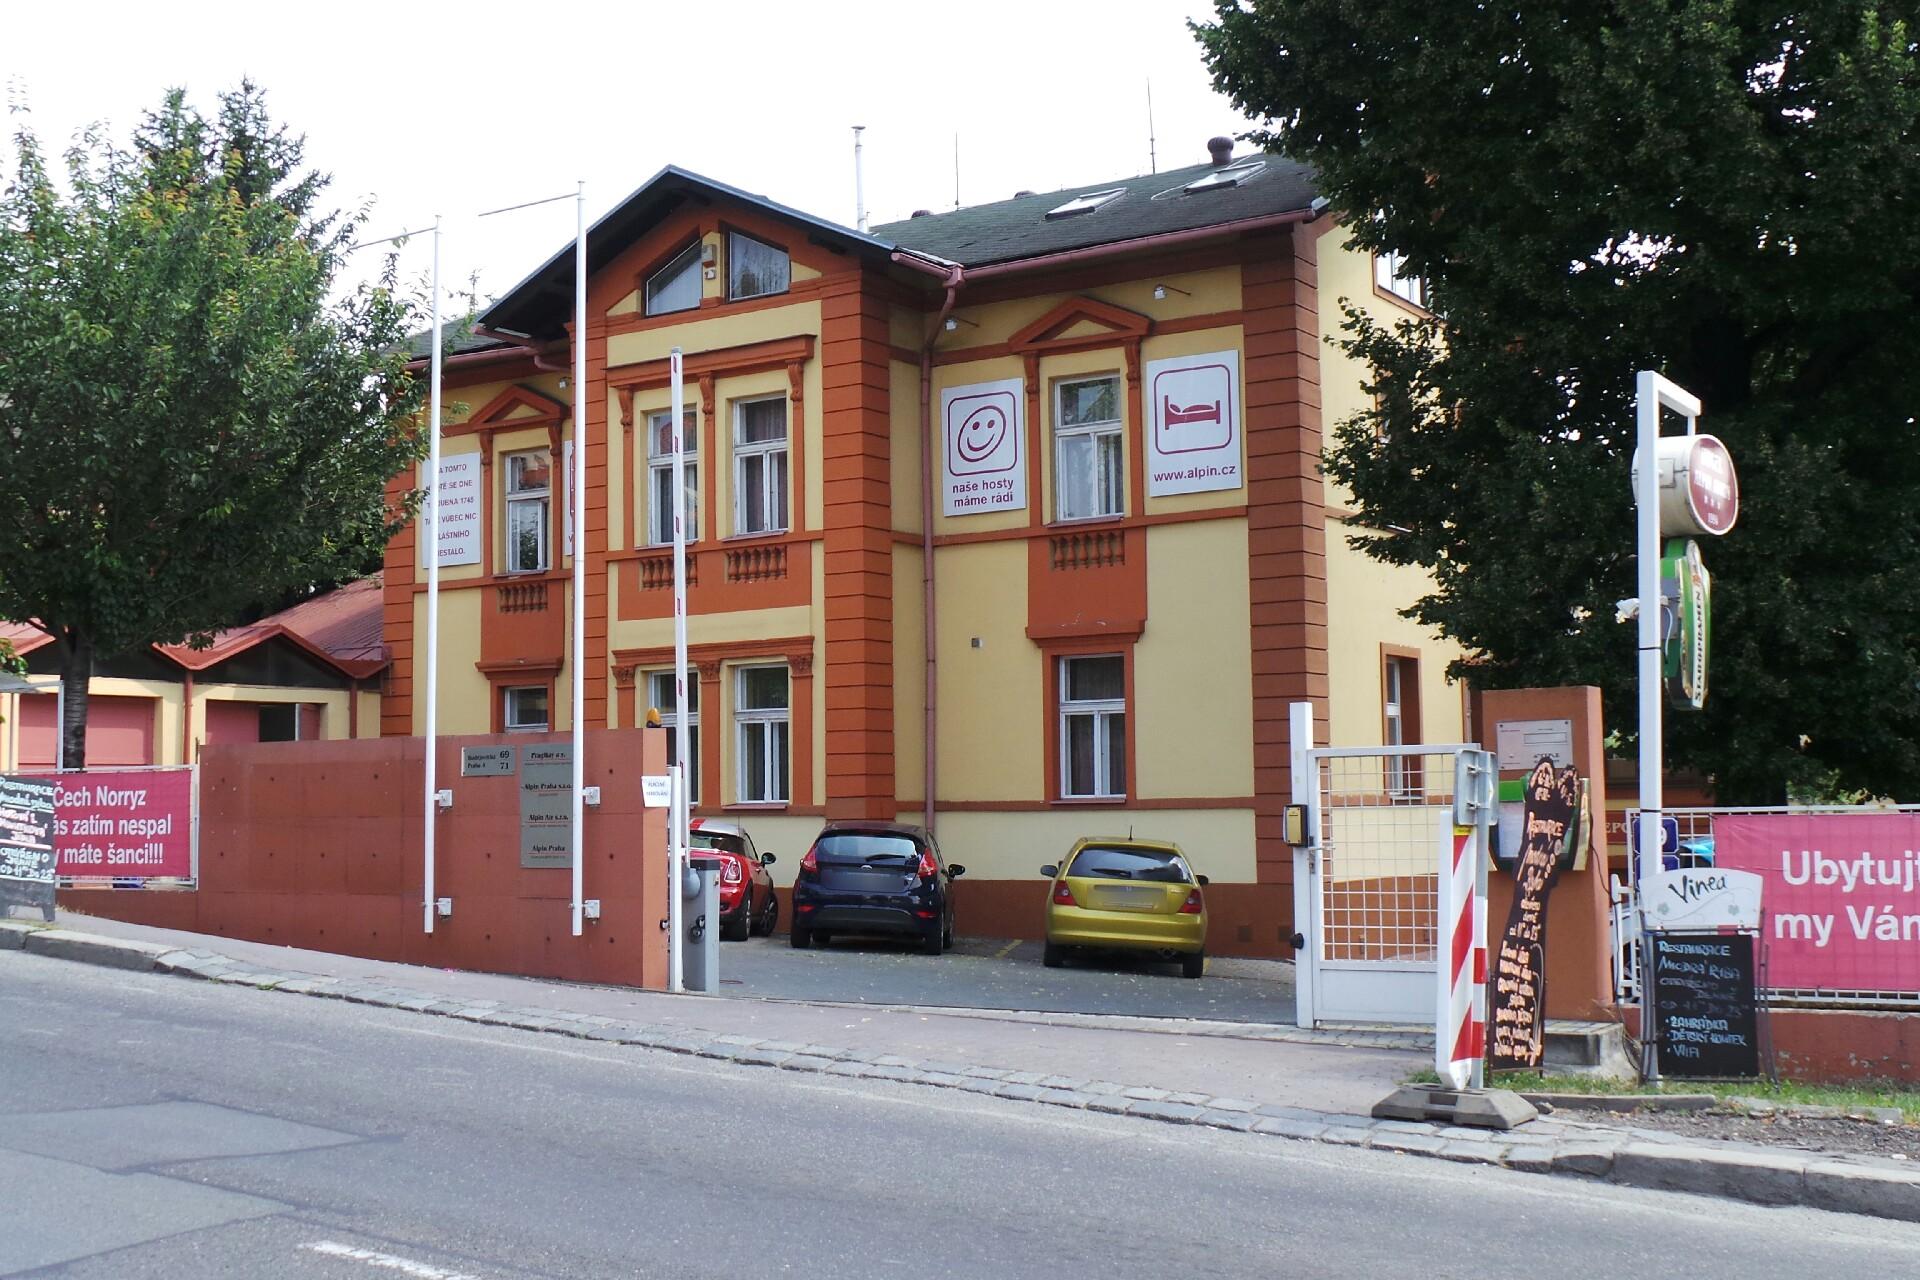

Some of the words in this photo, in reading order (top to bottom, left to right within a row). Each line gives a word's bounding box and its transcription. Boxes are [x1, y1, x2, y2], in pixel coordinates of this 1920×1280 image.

[445, 464, 467, 473] TOMTO
[1153, 465, 1236, 482] www.alpin.cz
[449, 481, 458, 489] SE
[952, 481, 978, 494] naše
[982, 478, 1014, 490] hosty
[954, 495, 988, 508] máme
[991, 491, 1013, 504] rádi
[464, 512, 478, 521] NIC
[500, 750, 510, 759] 69
[500, 762, 510, 770] 71
[53, 780, 91, 808] Čech
[96, 785, 147, 811] Norryz
[53, 814, 68, 836] ás
[72, 814, 114, 836] zatím
[118, 813, 172, 839] nespal
[64, 843, 103, 865] máte
[107, 842, 164, 865] šanci!!!
[1668, 875, 1728, 904] Vinea
[1774, 914, 1834, 948] my
